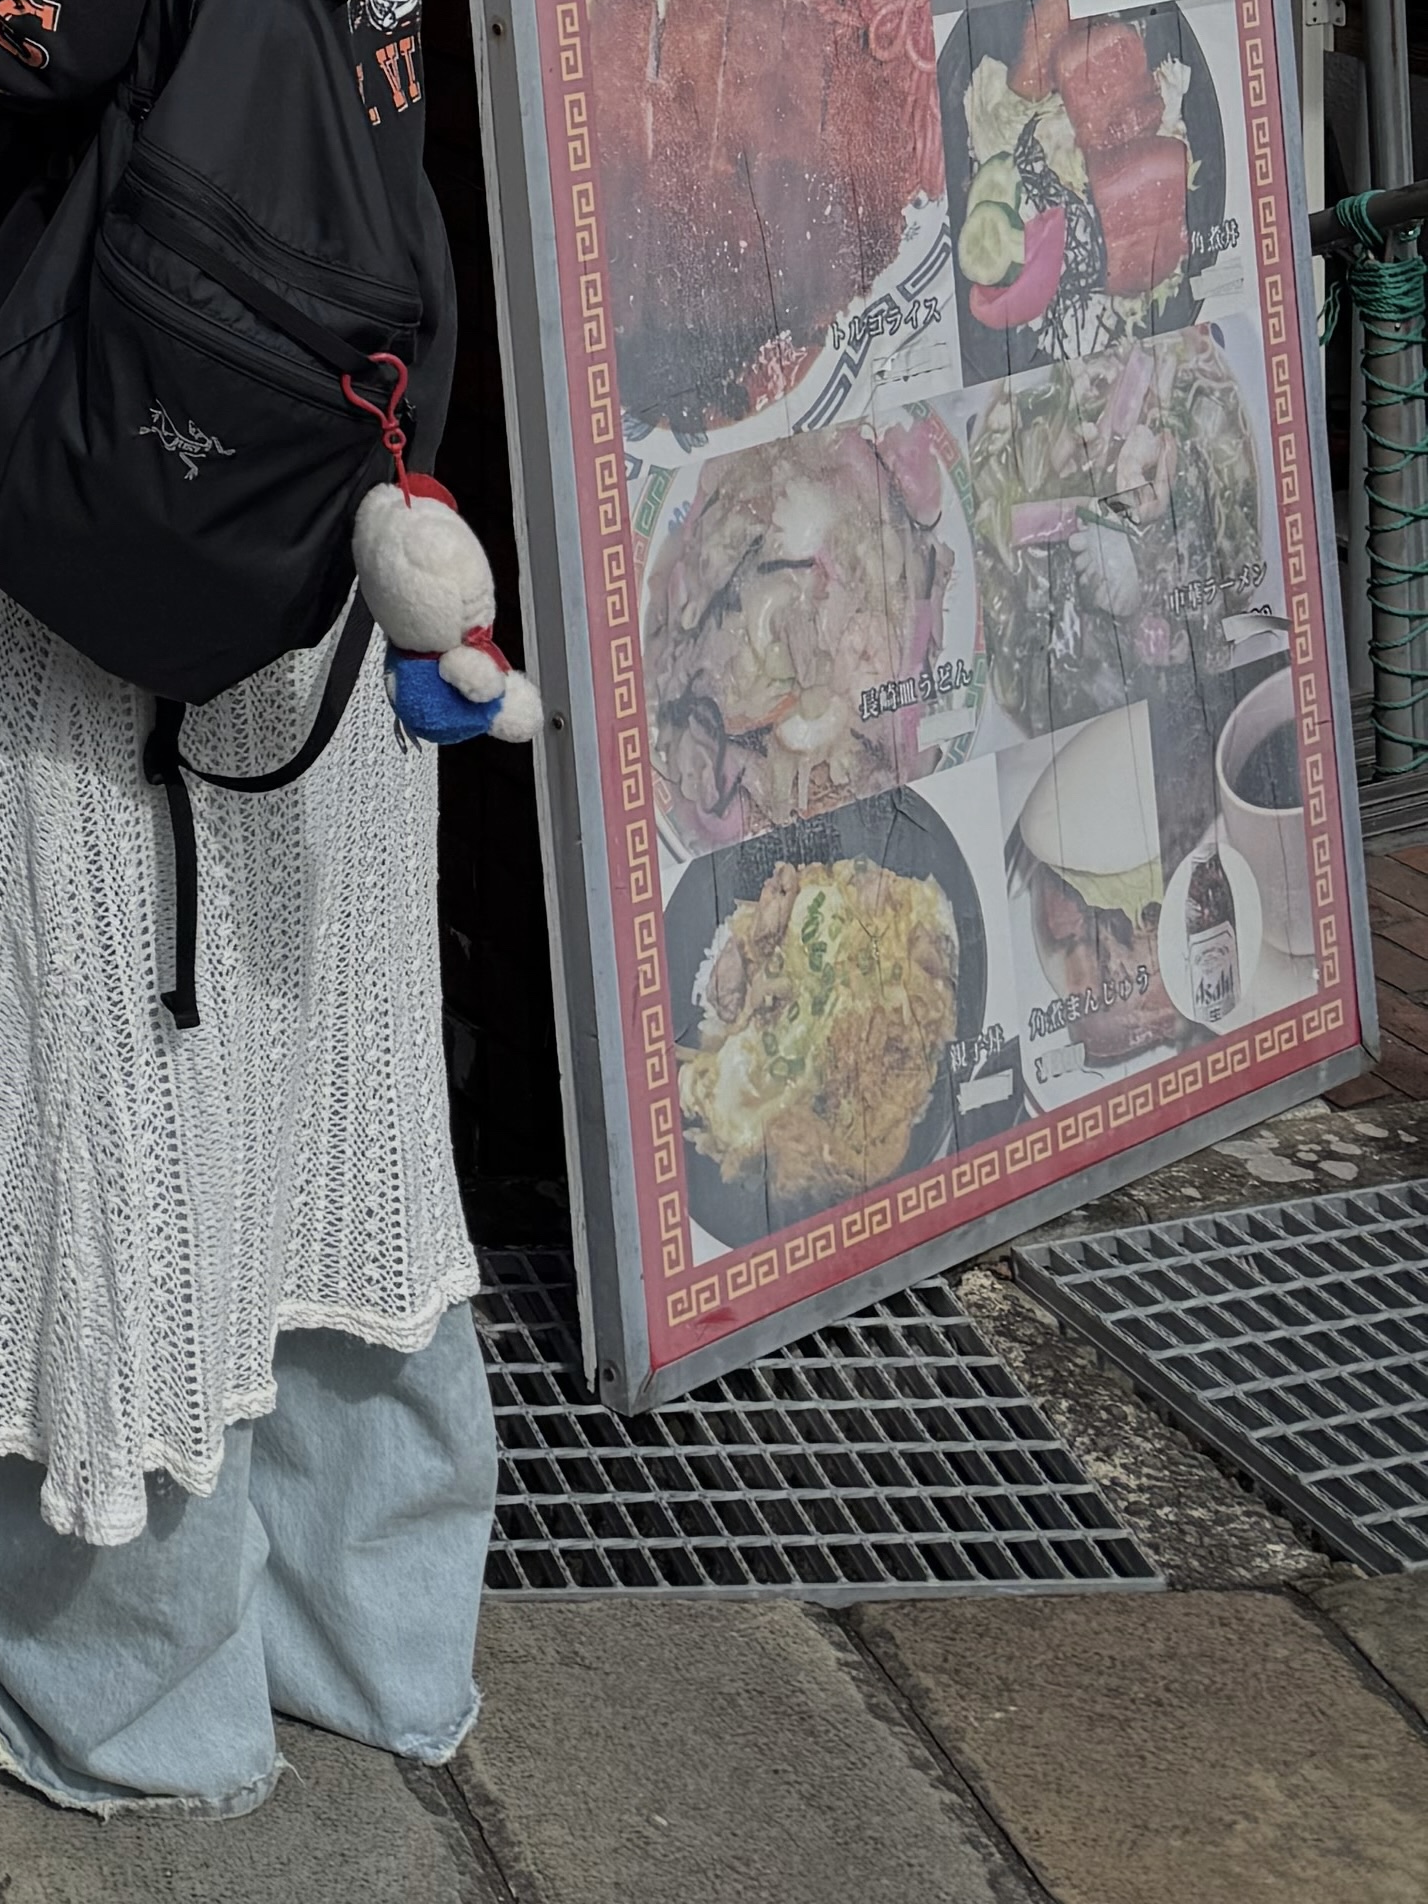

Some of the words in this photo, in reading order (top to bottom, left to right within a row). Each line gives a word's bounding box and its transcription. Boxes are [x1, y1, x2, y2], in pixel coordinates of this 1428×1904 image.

[831, 296, 943, 351] トルコライス
[1168, 562, 1269, 616] 中華ラーメン
[858, 659, 974, 721] 長崎皿うどん
[1195, 966, 1235, 1006] Asahi
[1208, 1008, 1223, 1022] 生
